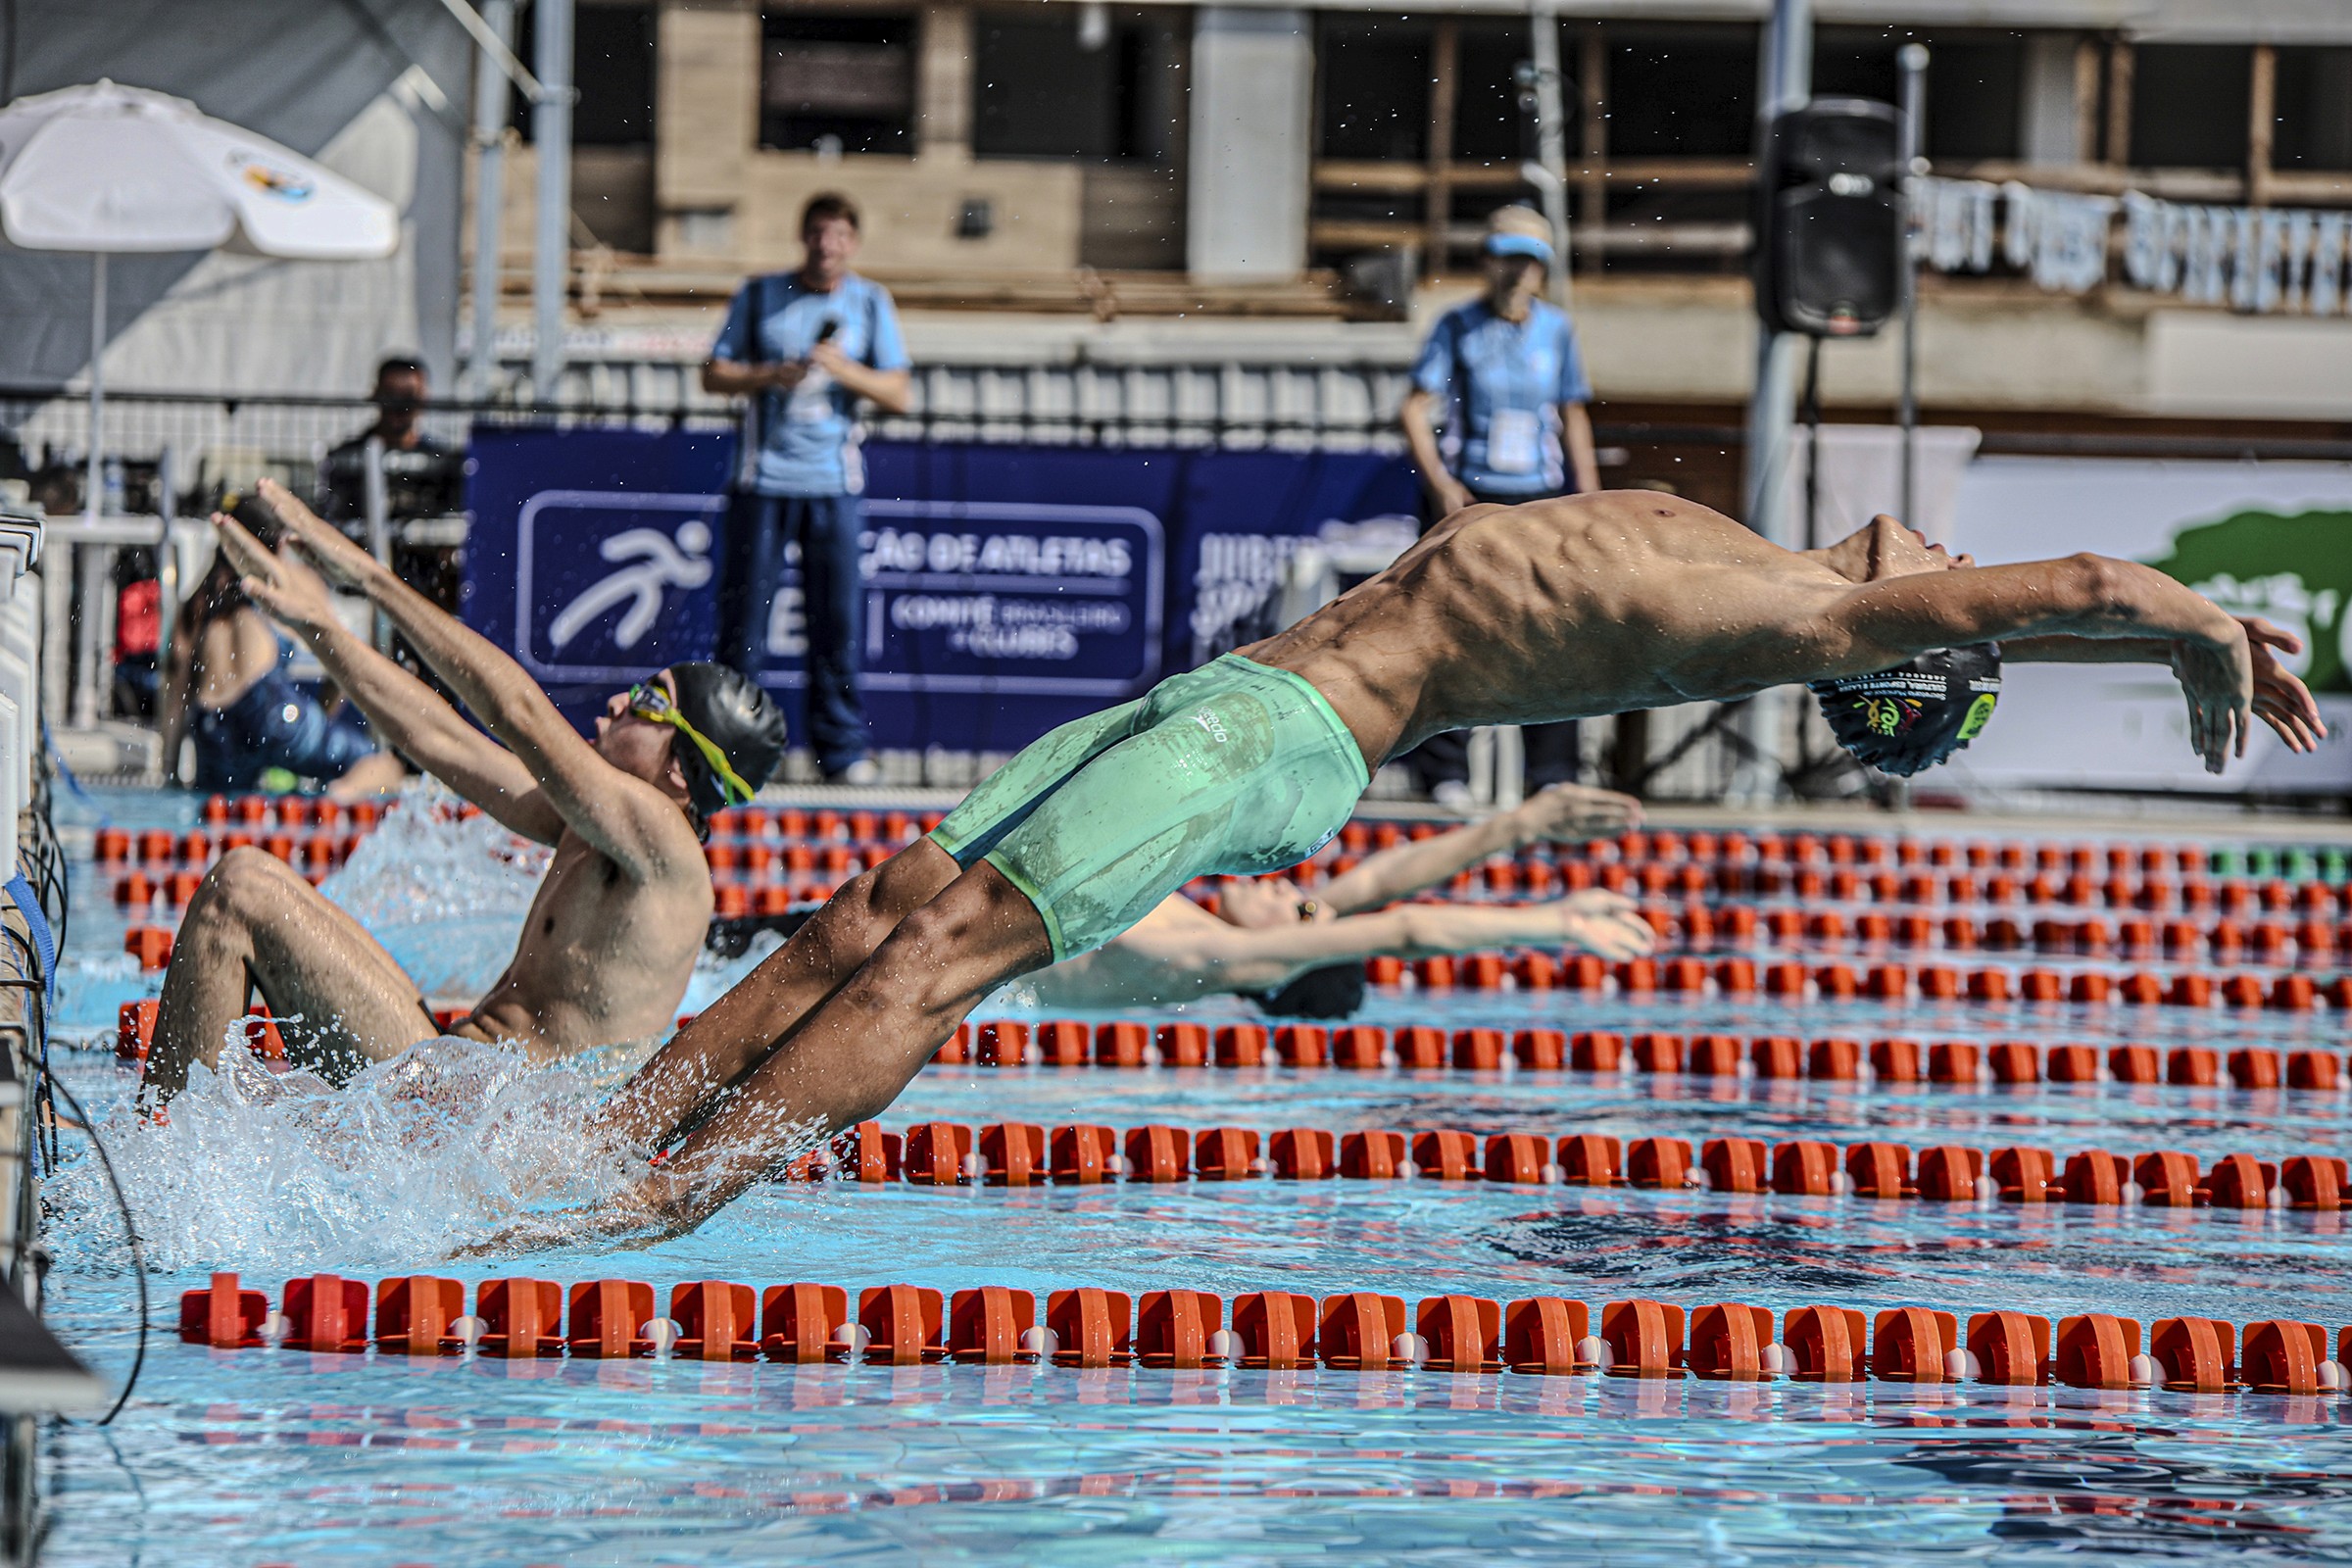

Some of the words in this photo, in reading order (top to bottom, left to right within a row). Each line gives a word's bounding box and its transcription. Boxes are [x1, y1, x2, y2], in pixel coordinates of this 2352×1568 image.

[928, 532, 978, 572] DE
[980, 533, 1132, 576] ATLETAS
[1870, 680, 1907, 689] ESPORTE
[1199, 706, 1227, 742] speedo
